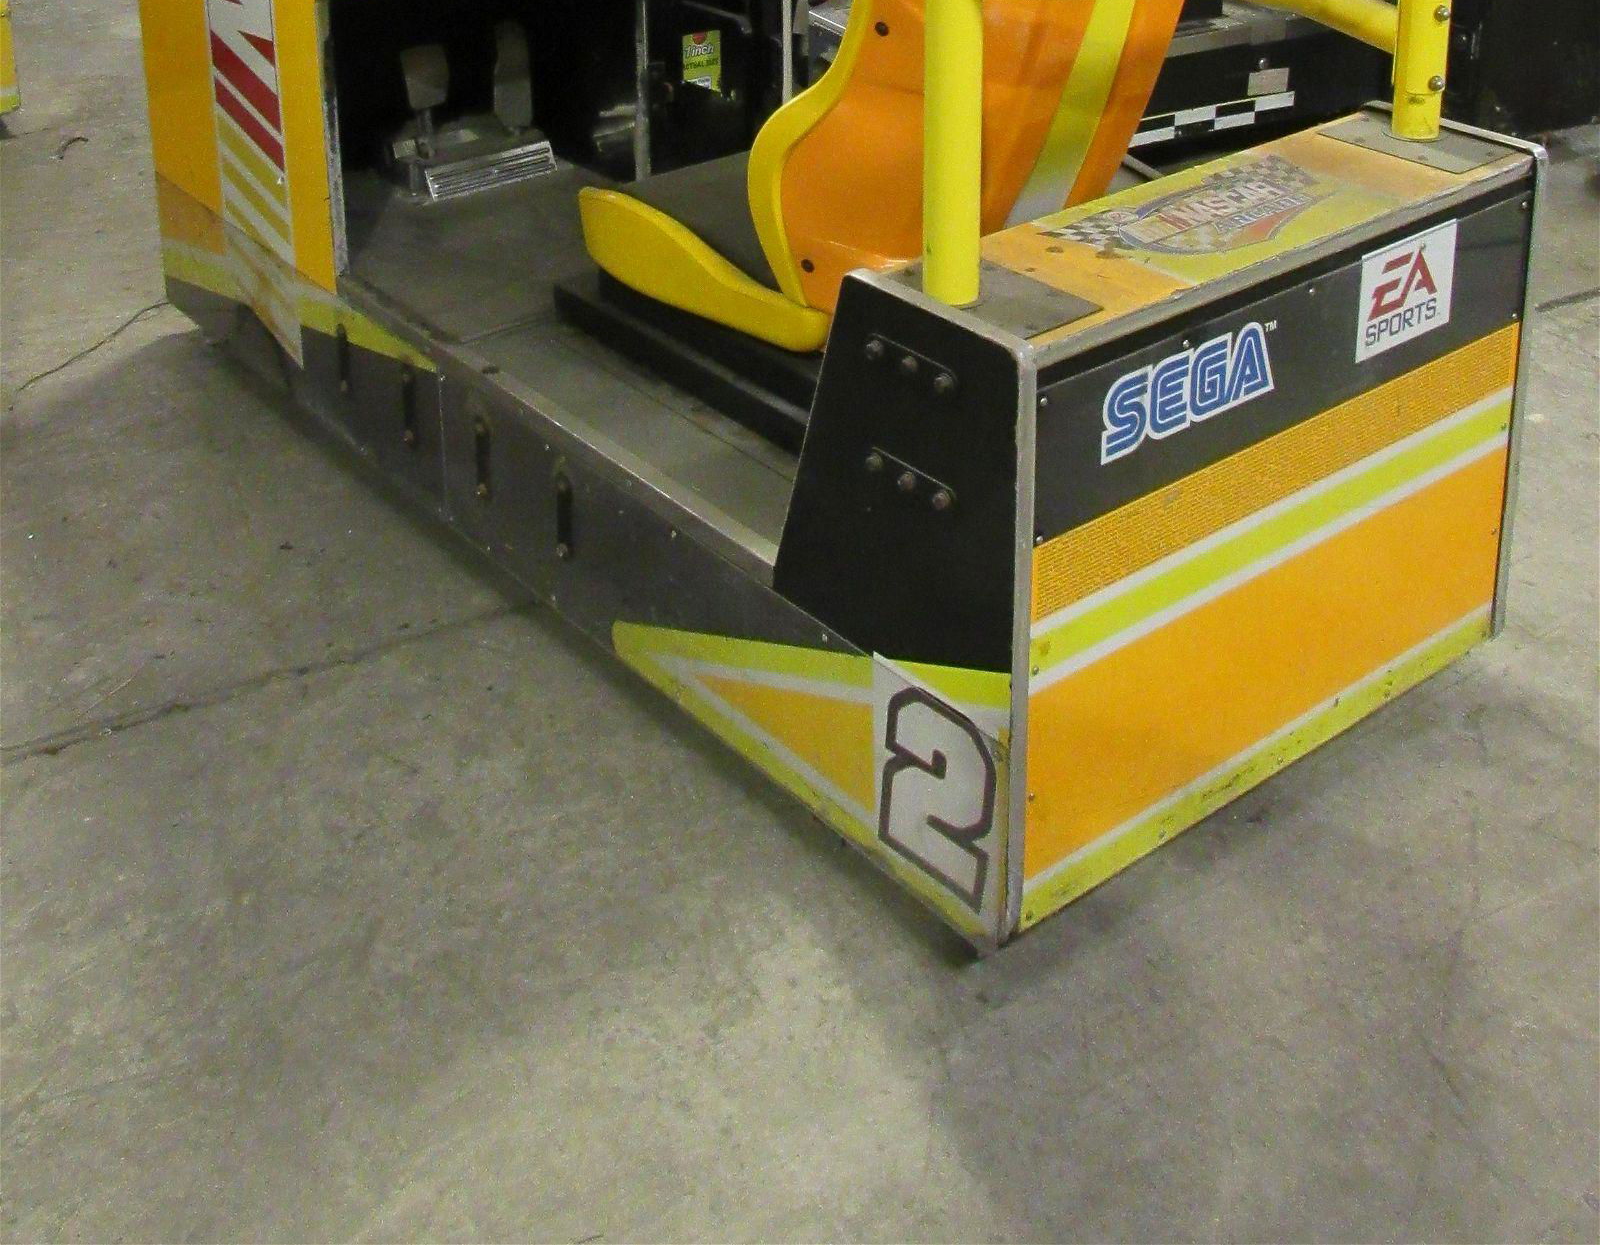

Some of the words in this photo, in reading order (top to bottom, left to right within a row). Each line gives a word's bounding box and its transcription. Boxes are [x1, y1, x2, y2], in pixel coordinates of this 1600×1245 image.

[1170, 180, 1287, 229] NASCAR
[1368, 247, 1438, 322] EA
[1363, 296, 1438, 347] SPORTS
[1101, 321, 1276, 466] SEGA
